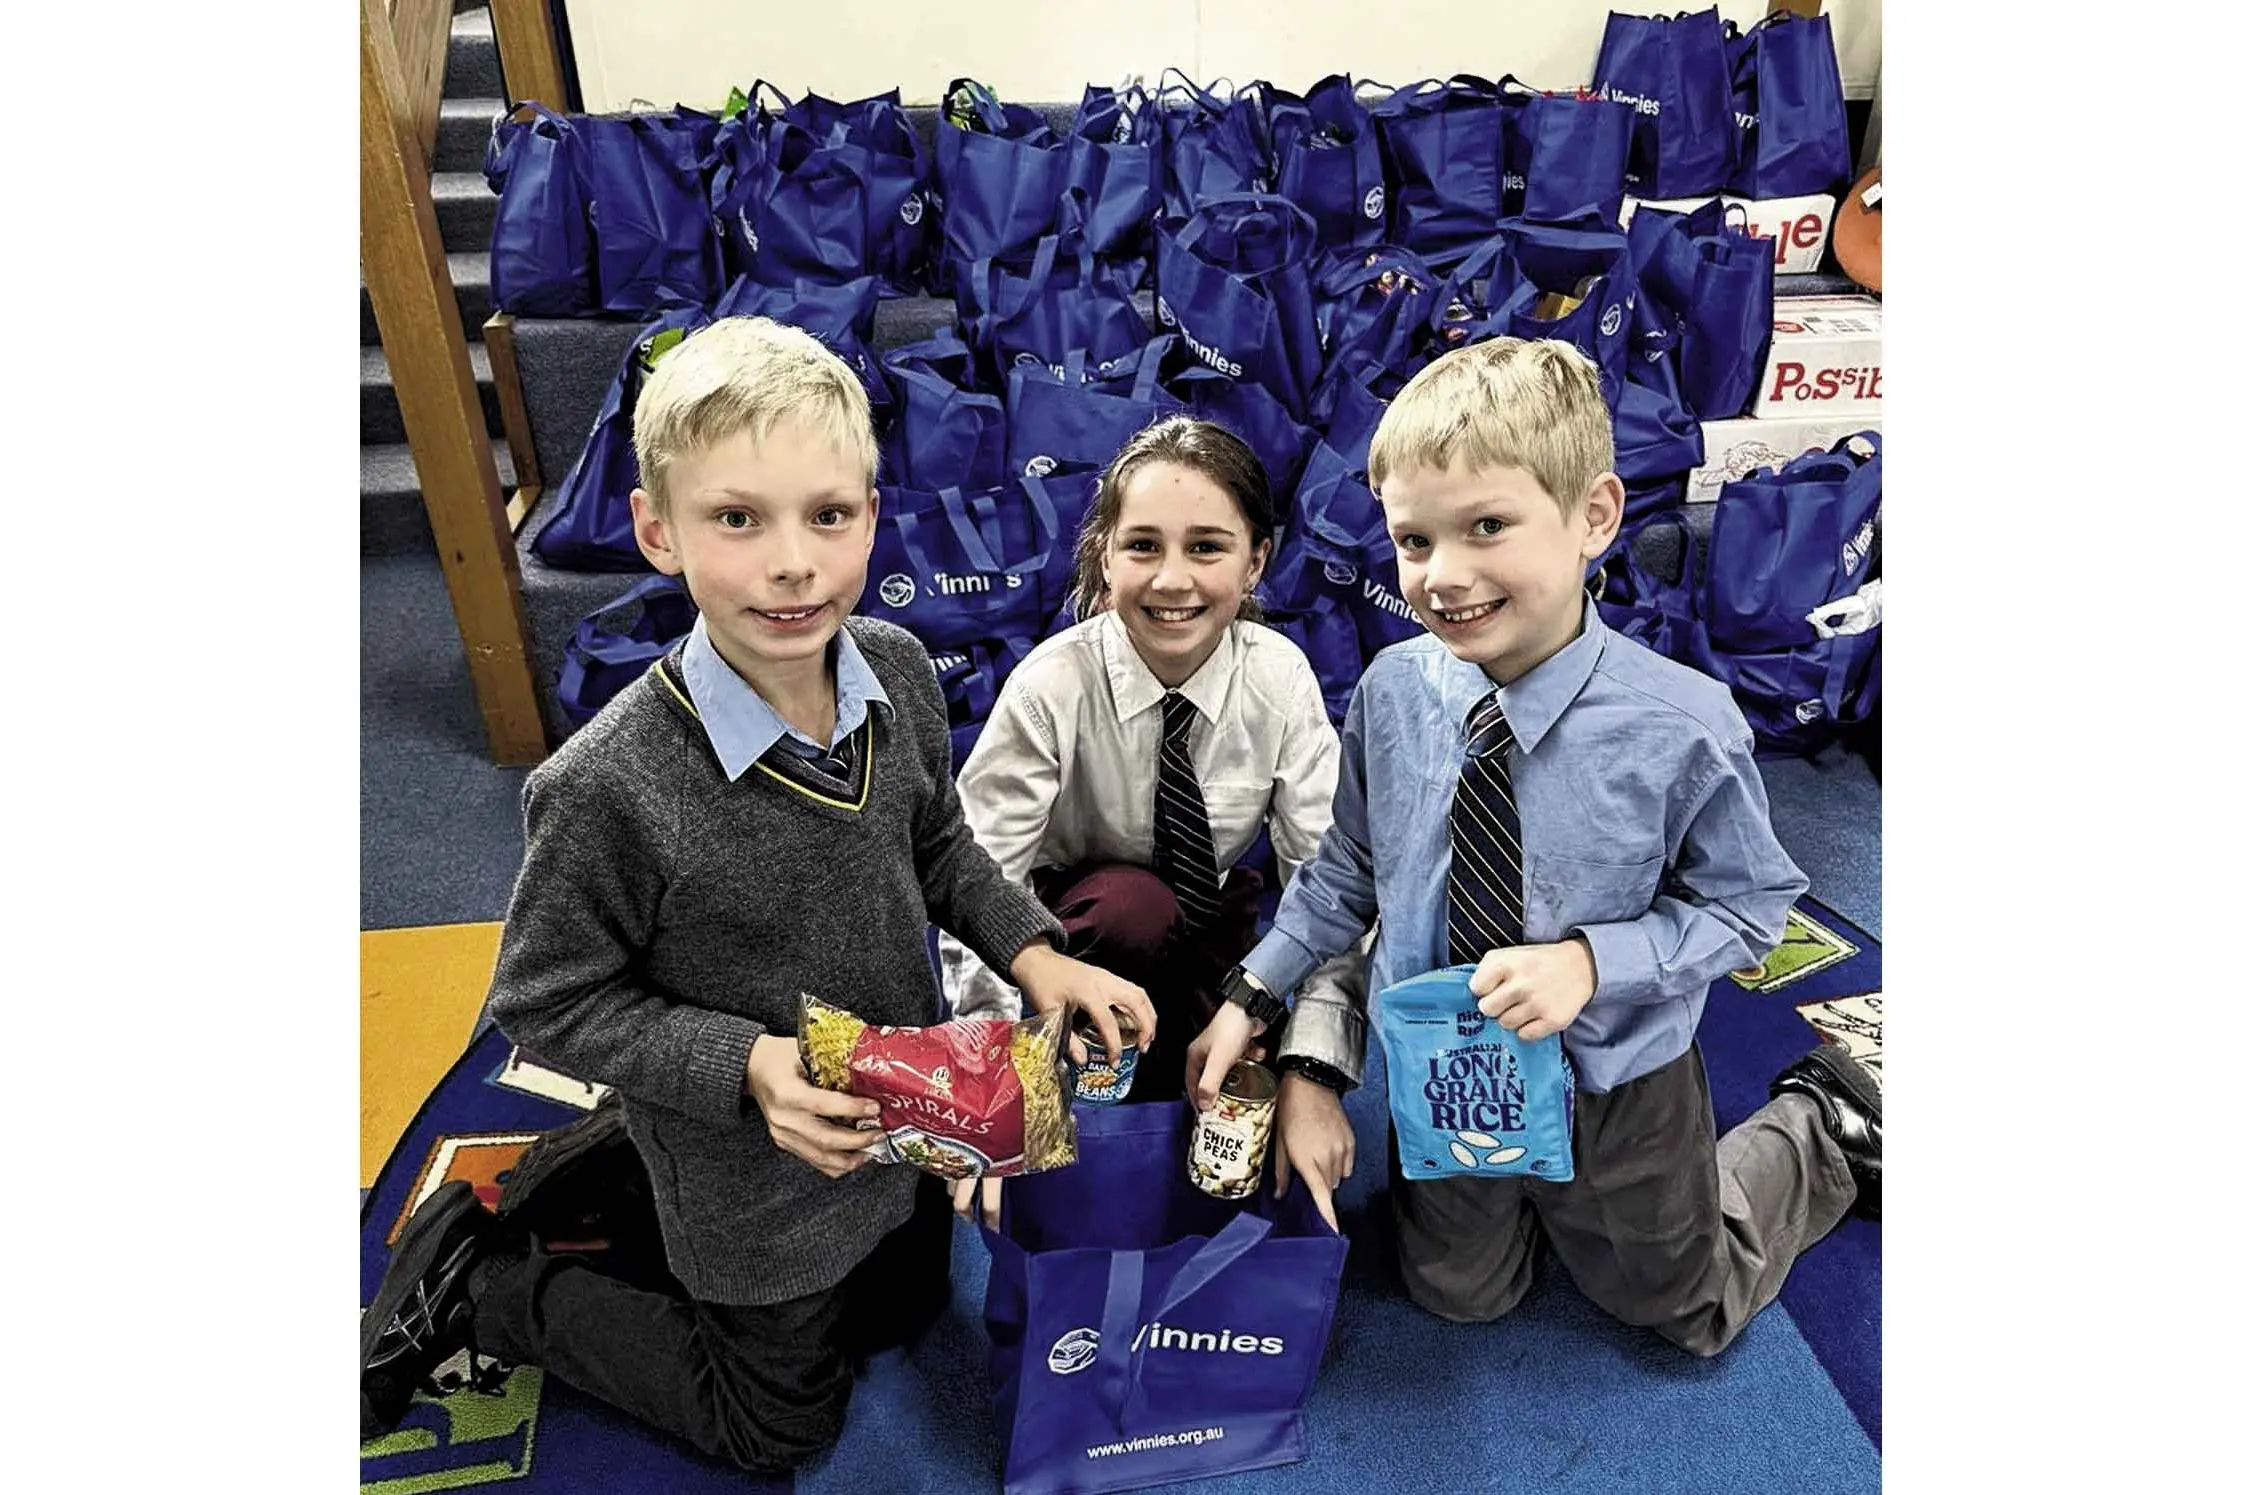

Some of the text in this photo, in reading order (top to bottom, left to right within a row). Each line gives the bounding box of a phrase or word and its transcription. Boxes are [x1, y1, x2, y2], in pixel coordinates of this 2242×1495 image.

[1428, 1053, 1517, 1081] LONG
[1076, 1081, 1117, 1098] BEANS
[1423, 1079, 1528, 1105] GRAIN
[882, 1093, 995, 1135] SPIRALS
[1430, 1103, 1527, 1133] RICE
[1203, 1128, 1245, 1151] CHICK
[1203, 1141, 1238, 1162] PEAS
[1086, 1426, 1225, 1459] www.vinnies.org.au
